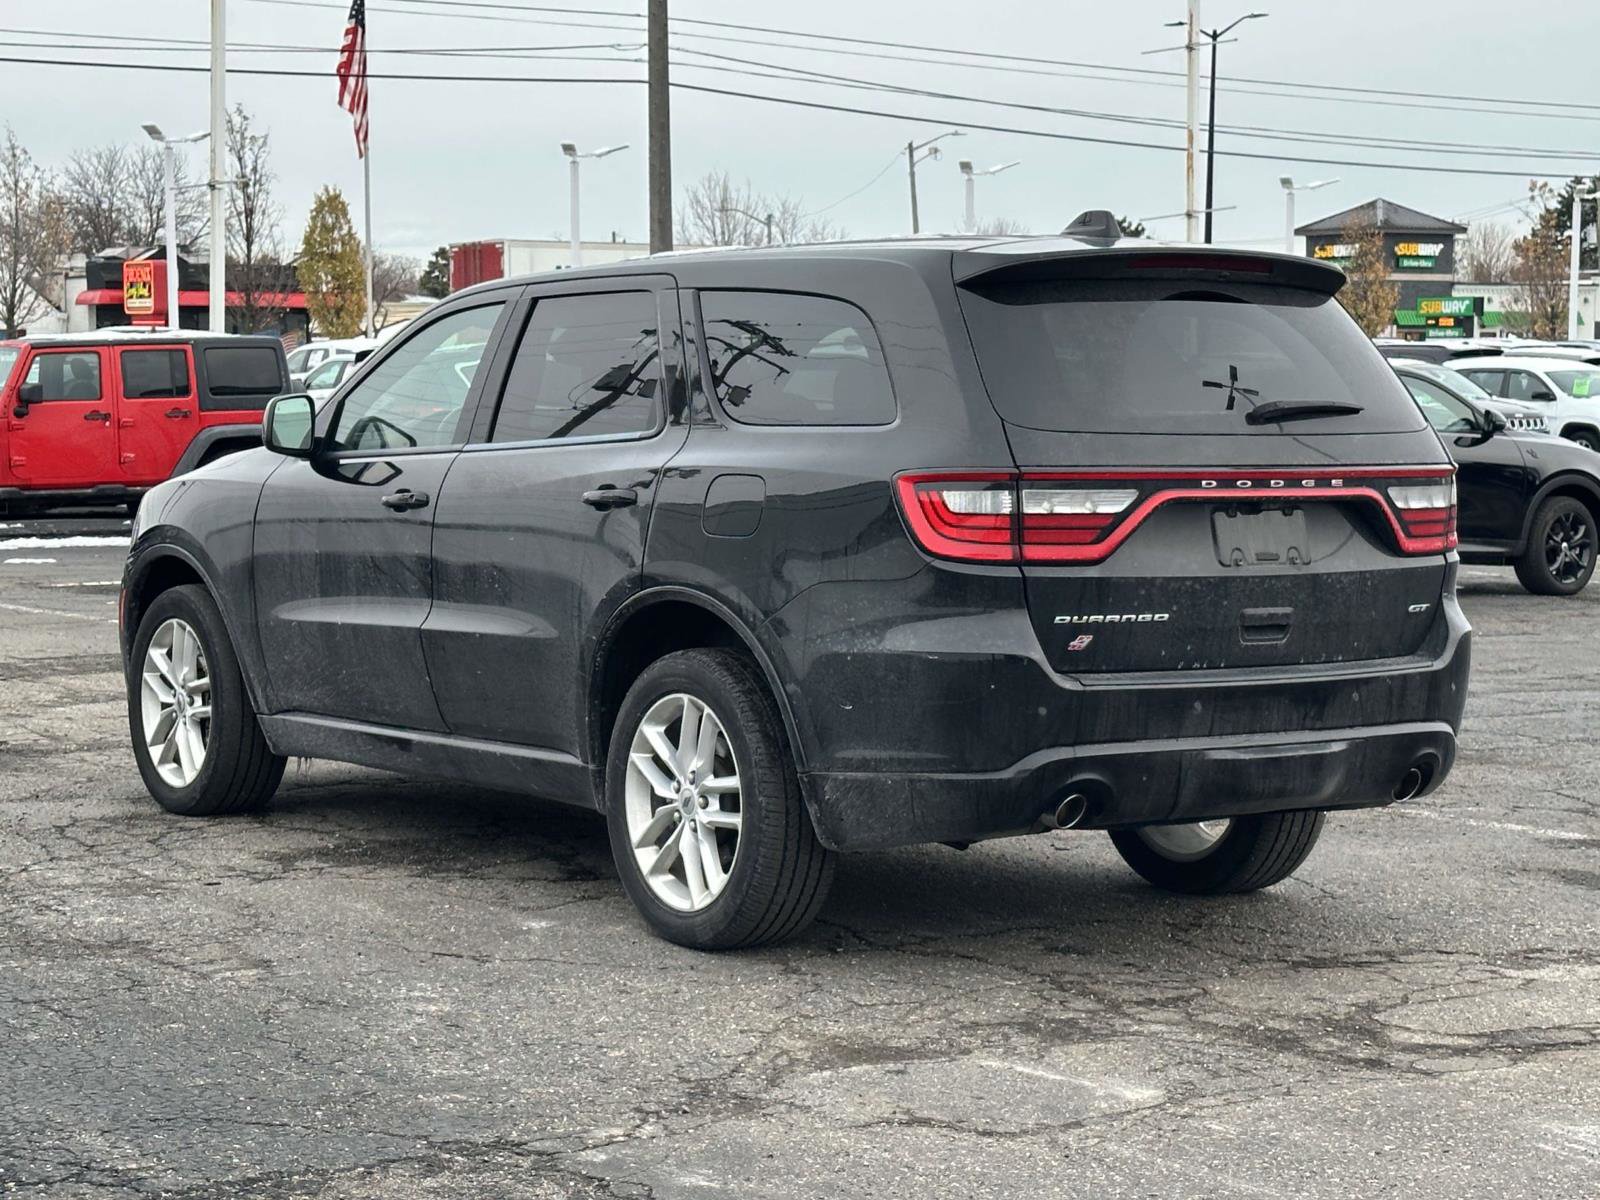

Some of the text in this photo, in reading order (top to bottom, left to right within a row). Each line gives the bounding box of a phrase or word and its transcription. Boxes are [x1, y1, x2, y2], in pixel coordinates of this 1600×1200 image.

[1394, 242, 1444, 256] SUBWAY
[1419, 299, 1470, 314] SUBWAY
[1201, 479, 1344, 488] DODGE
[1408, 603, 1431, 613] GT
[1053, 613, 1170, 624] DURANGO
